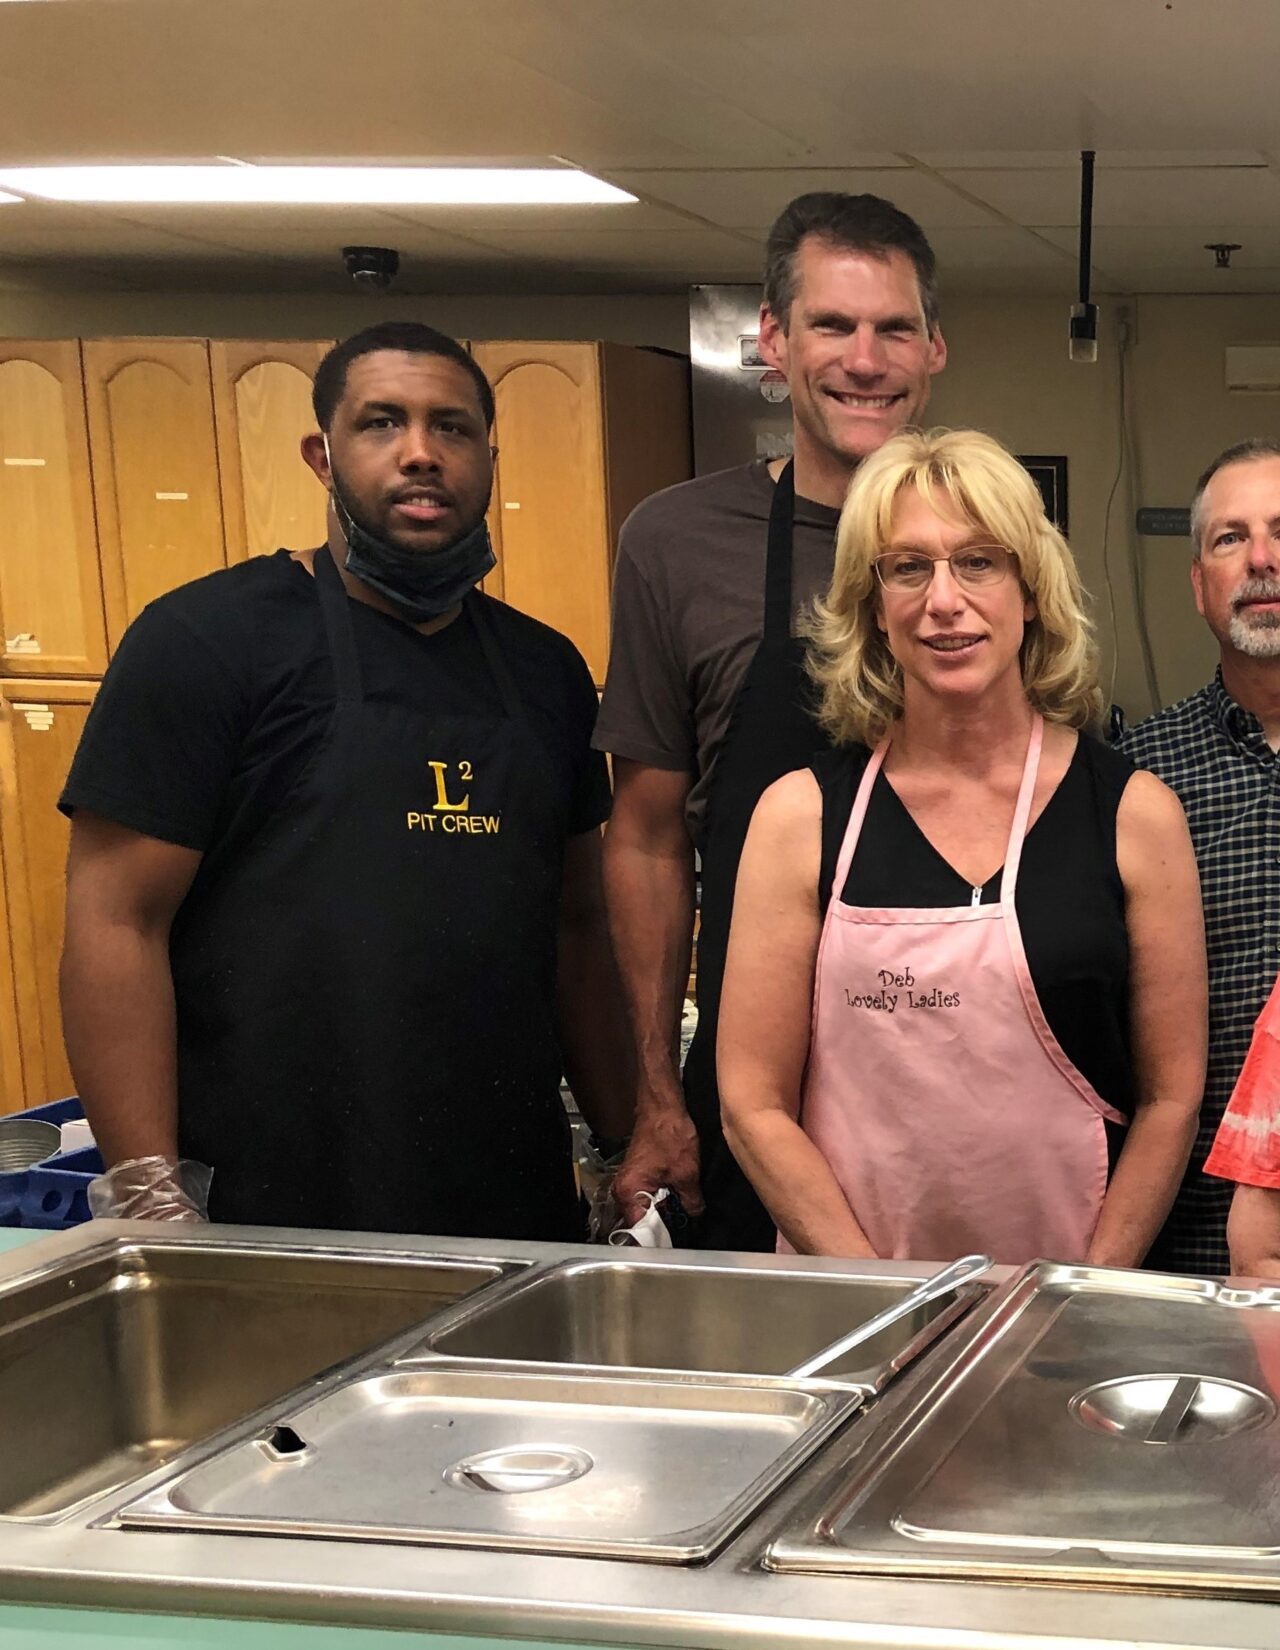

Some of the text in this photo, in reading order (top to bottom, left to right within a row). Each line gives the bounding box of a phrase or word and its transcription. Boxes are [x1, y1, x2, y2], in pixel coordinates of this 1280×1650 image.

[407, 812, 500, 834] PIT CREW
[878, 966, 915, 988] Deb
[844, 988, 961, 1013] Lovely Ladies
